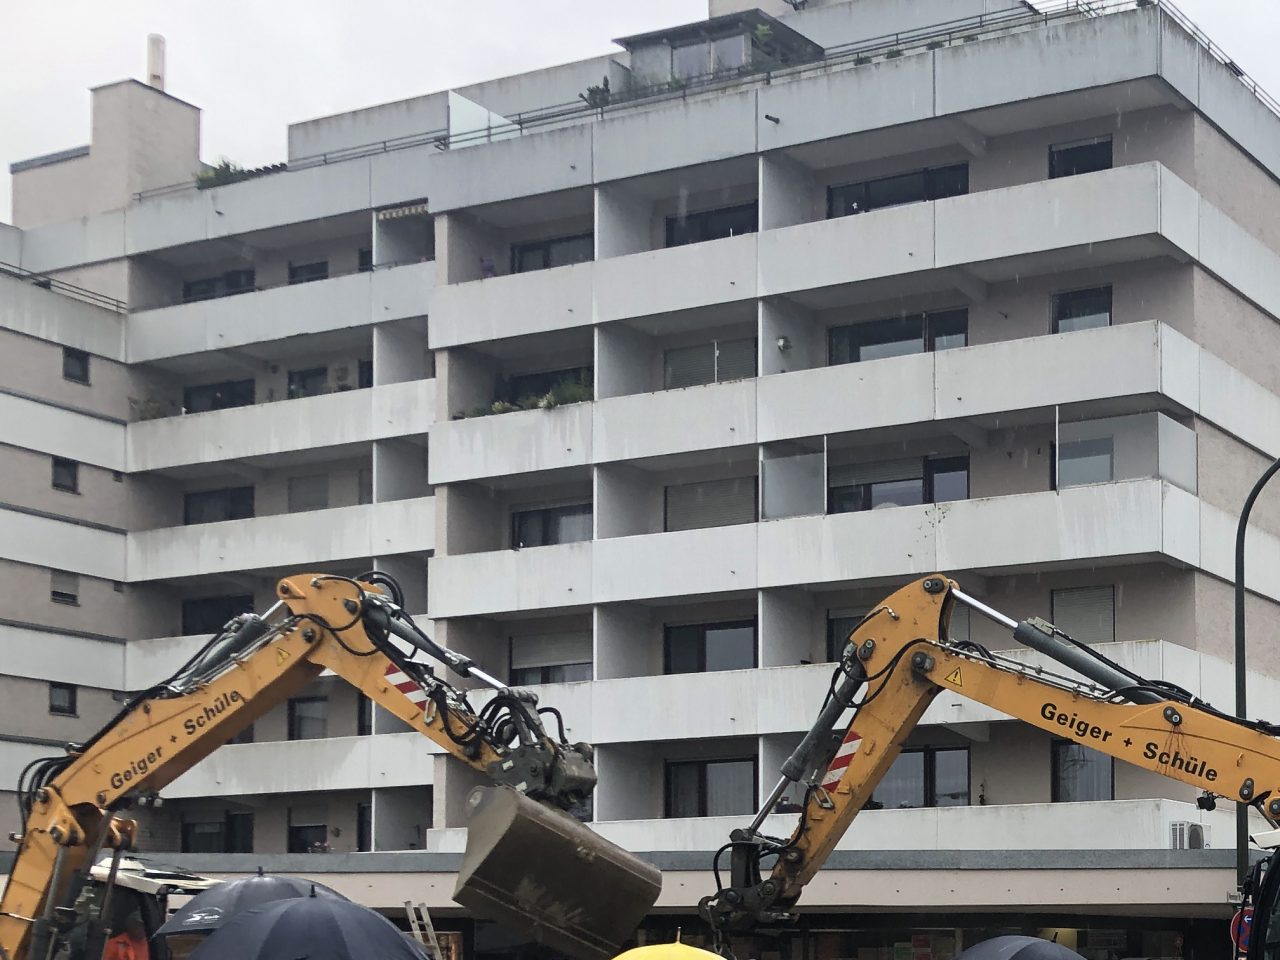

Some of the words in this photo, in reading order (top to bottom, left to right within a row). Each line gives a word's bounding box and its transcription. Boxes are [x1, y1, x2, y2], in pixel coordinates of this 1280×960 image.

[110, 745, 163, 790] Geiger
[183, 689, 241, 736] Schüle
[1040, 702, 1113, 742] Geiger
[1143, 741, 1218, 782] Schüle
